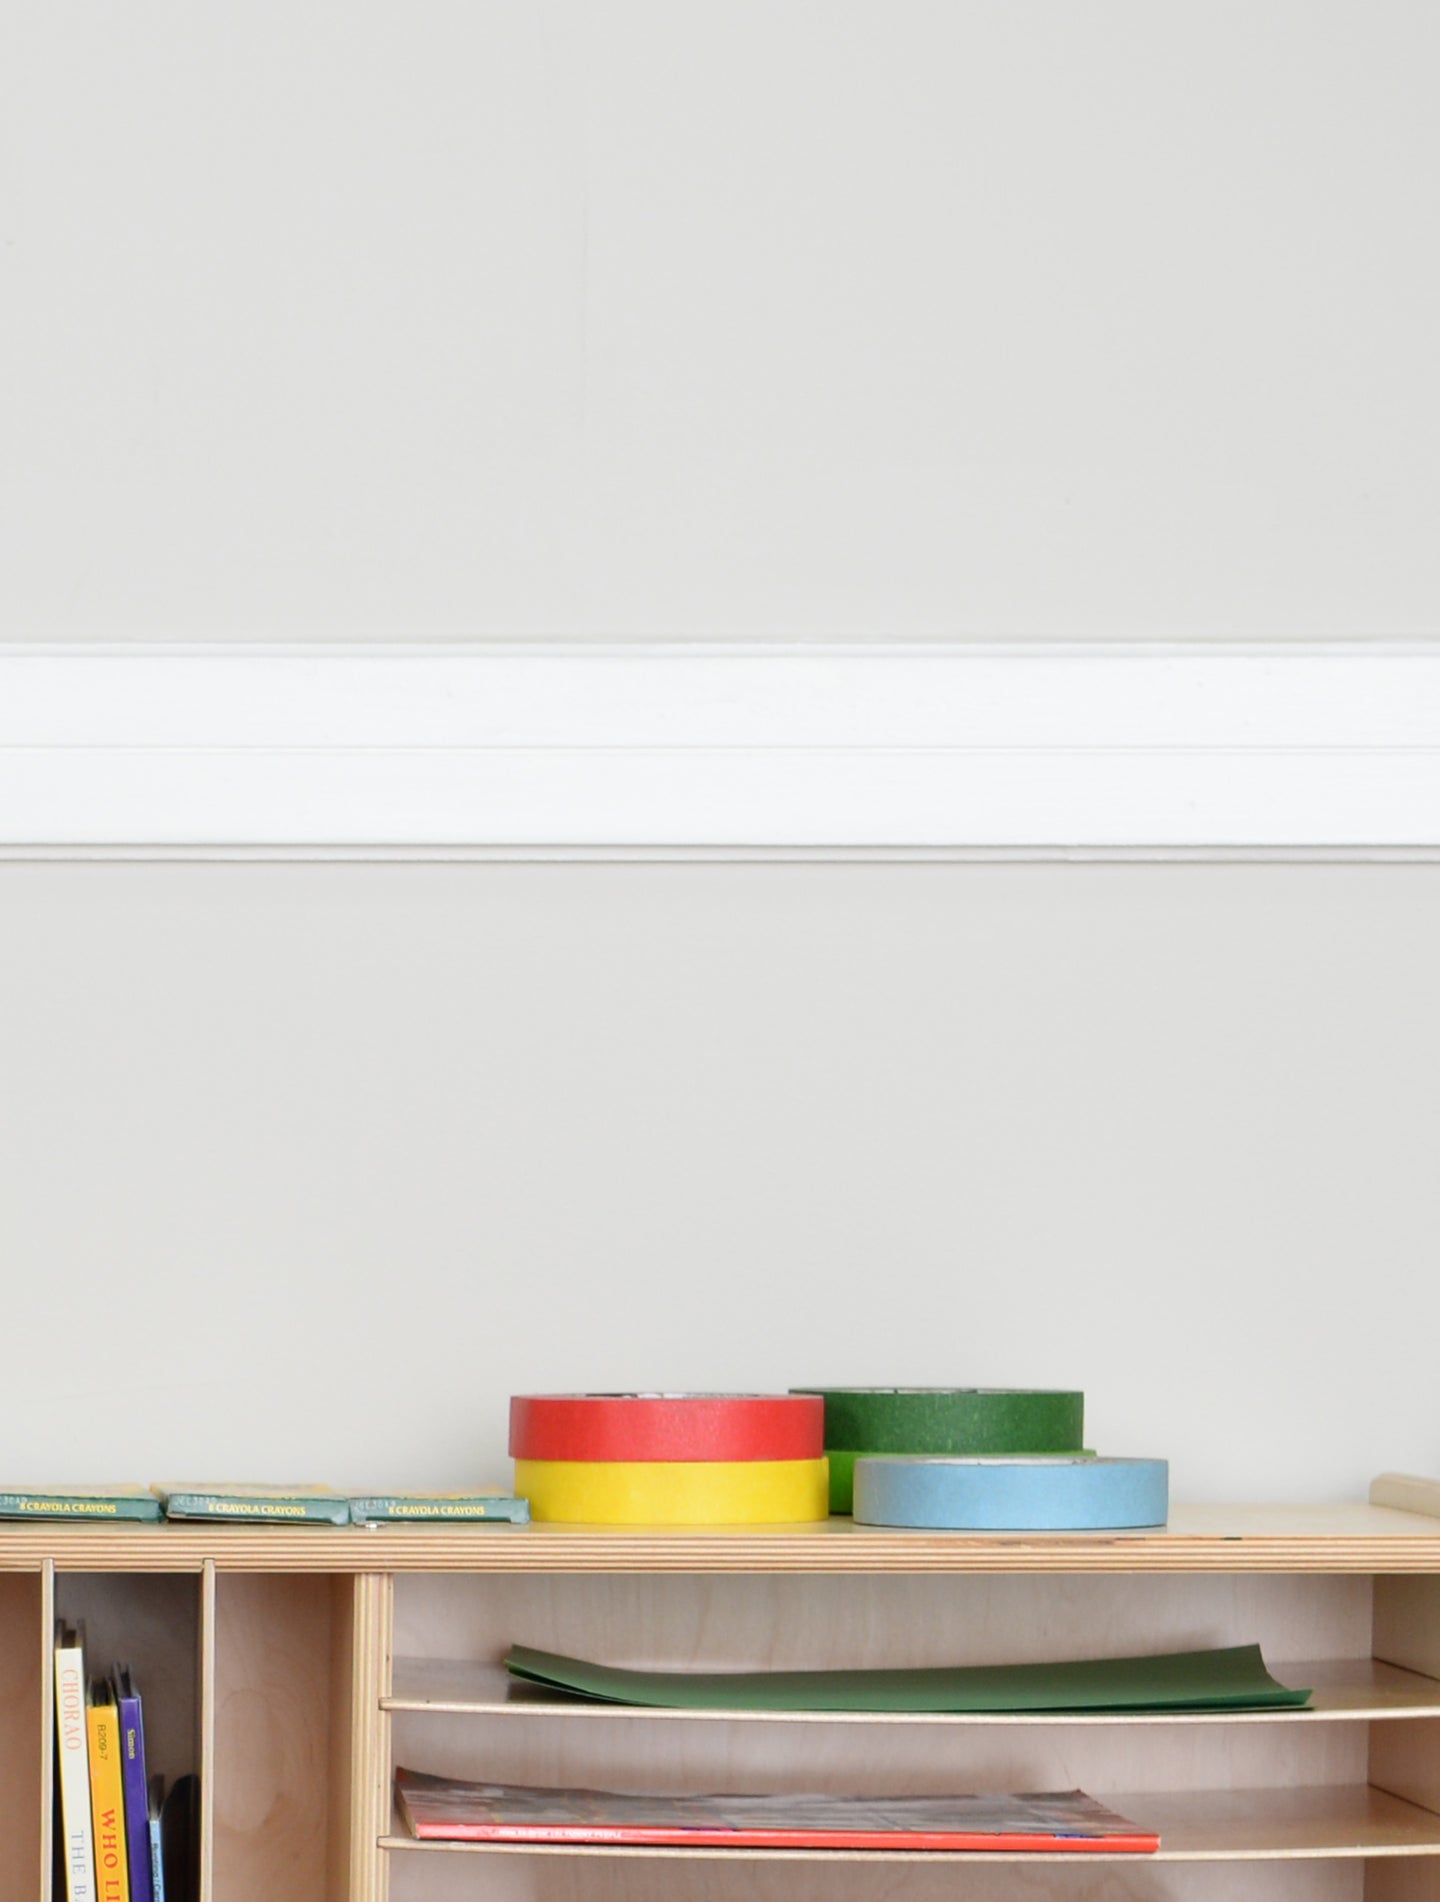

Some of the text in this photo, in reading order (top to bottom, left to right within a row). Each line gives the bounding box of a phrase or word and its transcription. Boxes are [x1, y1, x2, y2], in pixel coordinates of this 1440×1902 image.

[27, 1503, 70, 1512] CRAYOLA
[72, 1504, 116, 1514] CRAYONS
[216, 1504, 259, 1514] CRAYOLA
[262, 1506, 306, 1515] CRAYONS
[396, 1506, 439, 1515] CRAYOLA
[441, 1506, 485, 1515] CRAYONS
[62, 1668, 82, 1751] CHORAO
[97, 1724, 107, 1761] B209-7
[127, 1728, 137, 1760] Simon
[70, 1830, 86, 1874] THE
[101, 1809, 118, 1869] WHO
